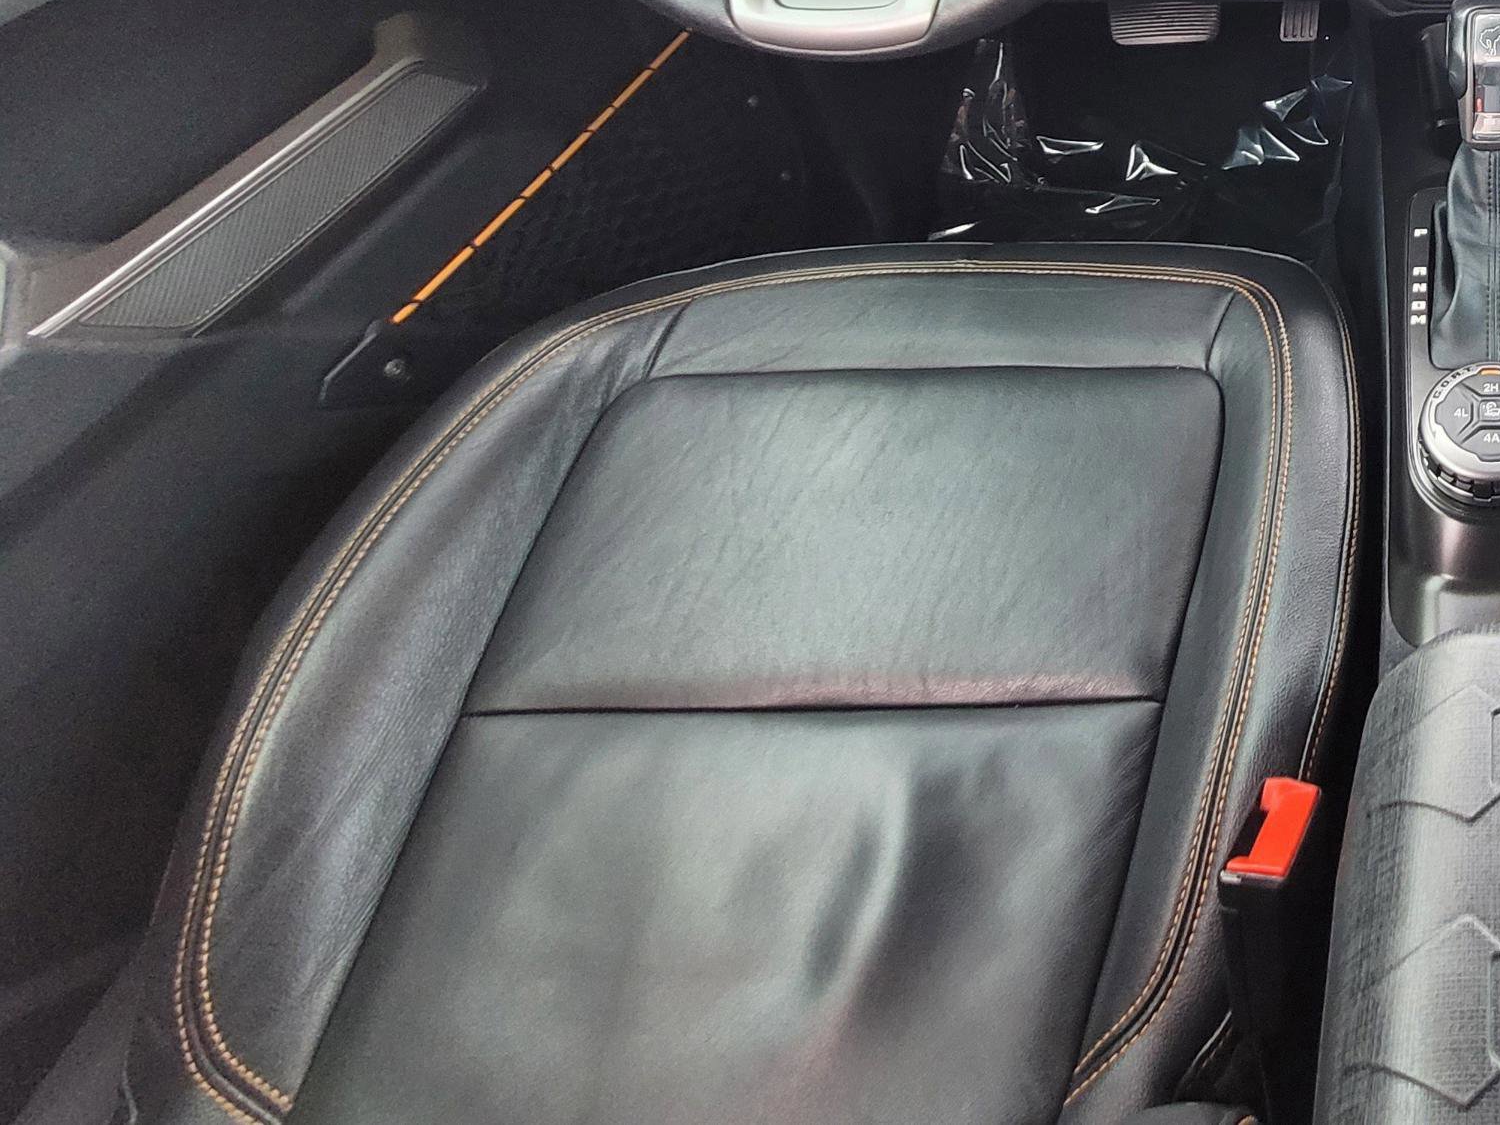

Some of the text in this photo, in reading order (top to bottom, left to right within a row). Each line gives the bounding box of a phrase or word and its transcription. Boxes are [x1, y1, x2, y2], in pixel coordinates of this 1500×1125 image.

[1412, 282, 1427, 293] N
[1410, 314, 1426, 325] M
[1483, 383, 1499, 393] 2H
[1453, 408, 1469, 417] 4L
[1483, 433, 1500, 443] 4A
